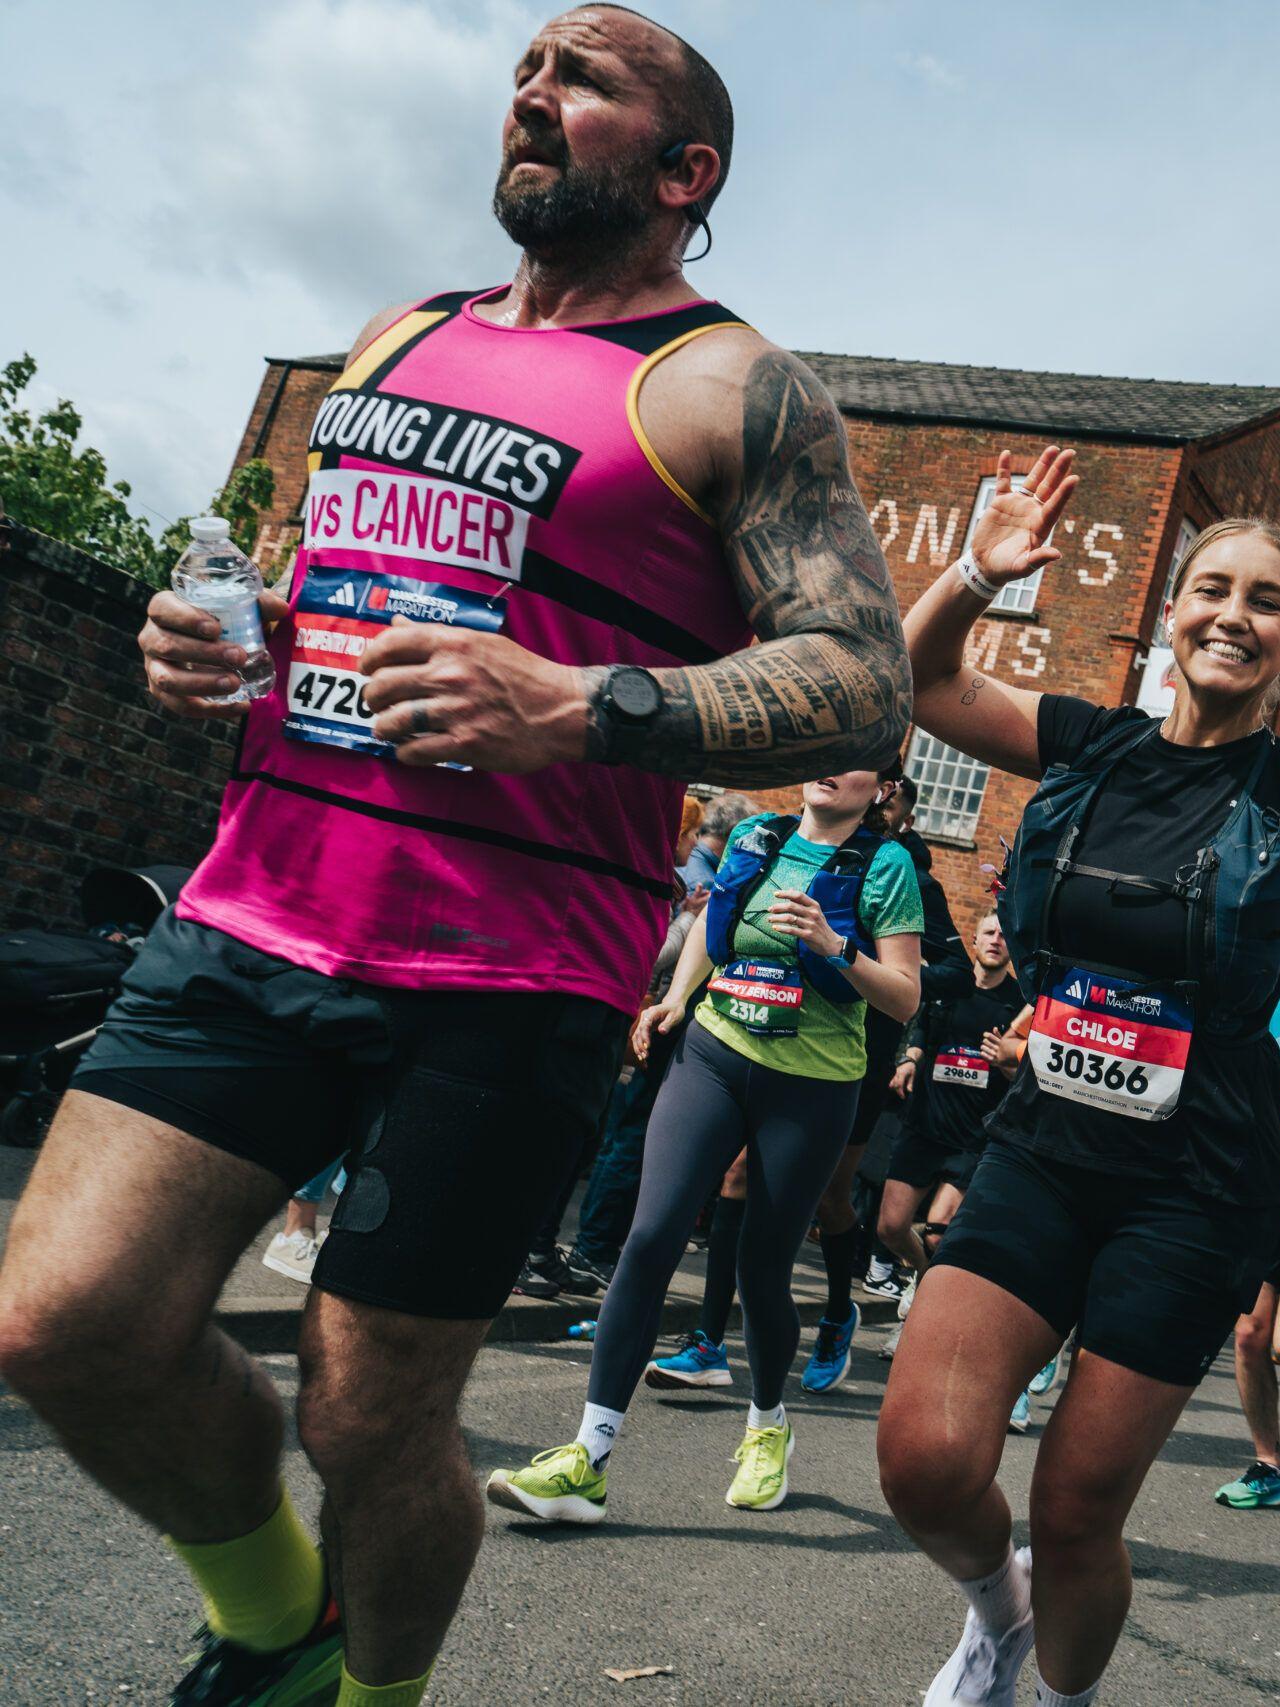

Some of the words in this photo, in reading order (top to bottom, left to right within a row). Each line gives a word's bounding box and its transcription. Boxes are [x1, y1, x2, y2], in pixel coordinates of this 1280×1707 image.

[422, 413, 562, 503] LIVES
[311, 494, 342, 538] VS
[353, 479, 512, 569] CANCER
[385, 598, 457, 623] MARATHON
[712, 980, 747, 995] BECKY
[747, 986, 797, 1003] BENSON
[729, 999, 769, 1024] 2314
[1105, 996, 1161, 1017] MARATHON
[1066, 1017, 1138, 1051] CHLOE
[944, 1067, 978, 1079] 29868
[1046, 1042, 1149, 1095] 30366
